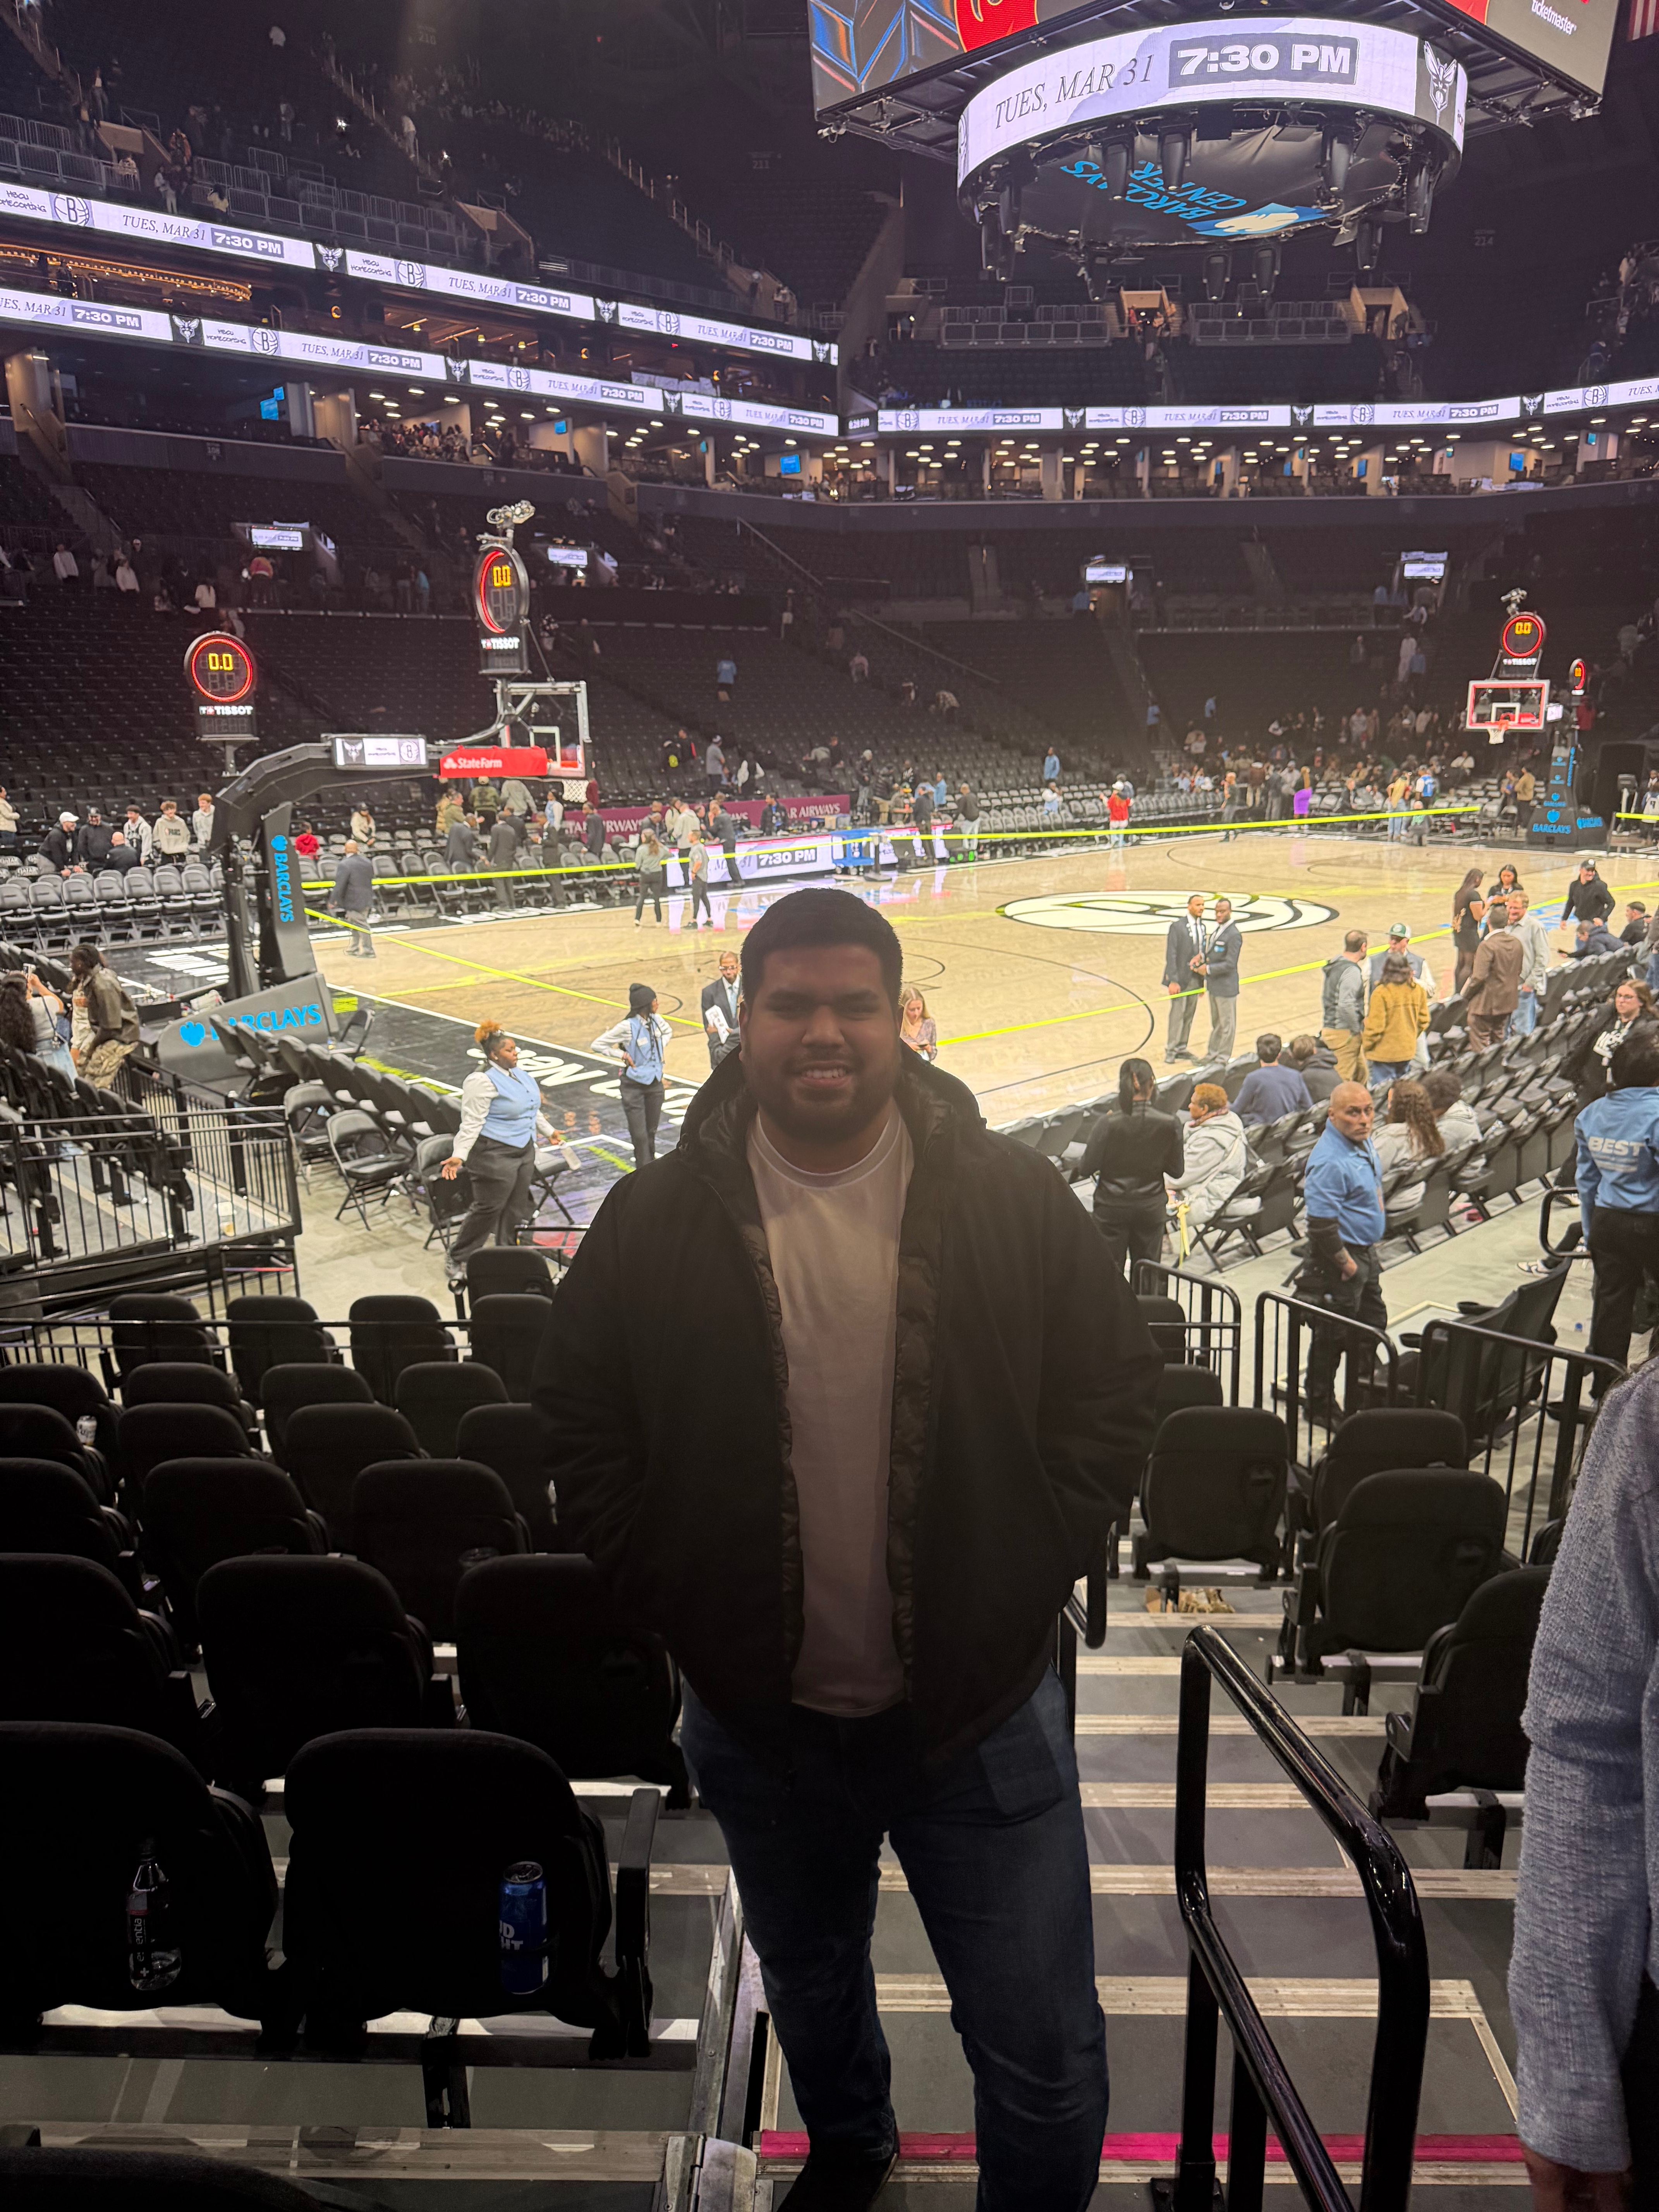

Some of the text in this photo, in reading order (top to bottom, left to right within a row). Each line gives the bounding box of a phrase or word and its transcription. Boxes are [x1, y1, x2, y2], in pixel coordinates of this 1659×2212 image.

[996, 43, 1350, 129] TUES, MAR 31 7:30 PM
[1060, 160, 1216, 220] BARCLYS
[0, 199, 46, 212] OMECOMING
[123, 215, 282, 255] TUES, MAR 31 7:30 PM
[449, 277, 569, 309] TUES, MAR 31 7:30 PM
[24, 301, 52, 315] MAR
[55, 306, 66, 317] 31
[74, 308, 112, 323] 7:30
[116, 314, 140, 328] PM
[751, 334, 775, 347] 7:30
[776, 339, 793, 351] PM
[302, 342, 421, 369] TUES, MAR 31 7:30 PM
[601, 387, 625, 398] 7:30
[627, 390, 643, 402] PM
[1628, 386, 1652, 396] TUES,
[994, 415, 1020, 423] 7:30
[1022, 414, 1040, 423] PM
[1221, 412, 1247, 420] 7:30
[1250, 411, 1267, 420] PM
[1451, 408, 1476, 417] 7:30
[1480, 406, 1497, 416] PM
[789, 415, 810, 426] 7:30
[810, 418, 824, 428] PM
[491, 637, 520, 649] TISSOT
[208, 653, 234, 671] 0.0
[214, 706, 254, 716] TISSOT
[800, 803, 840, 818] AIRWAYS
[1532, 823, 1571, 834] BARCLAYS
[758, 851, 792, 866] 7:30
[794, 848, 816, 863] PM
[274, 853, 294, 922] BARCLAYS
[210, 1003, 321, 1041] RCLAYS
[1588, 1136, 1646, 1157] BEST
